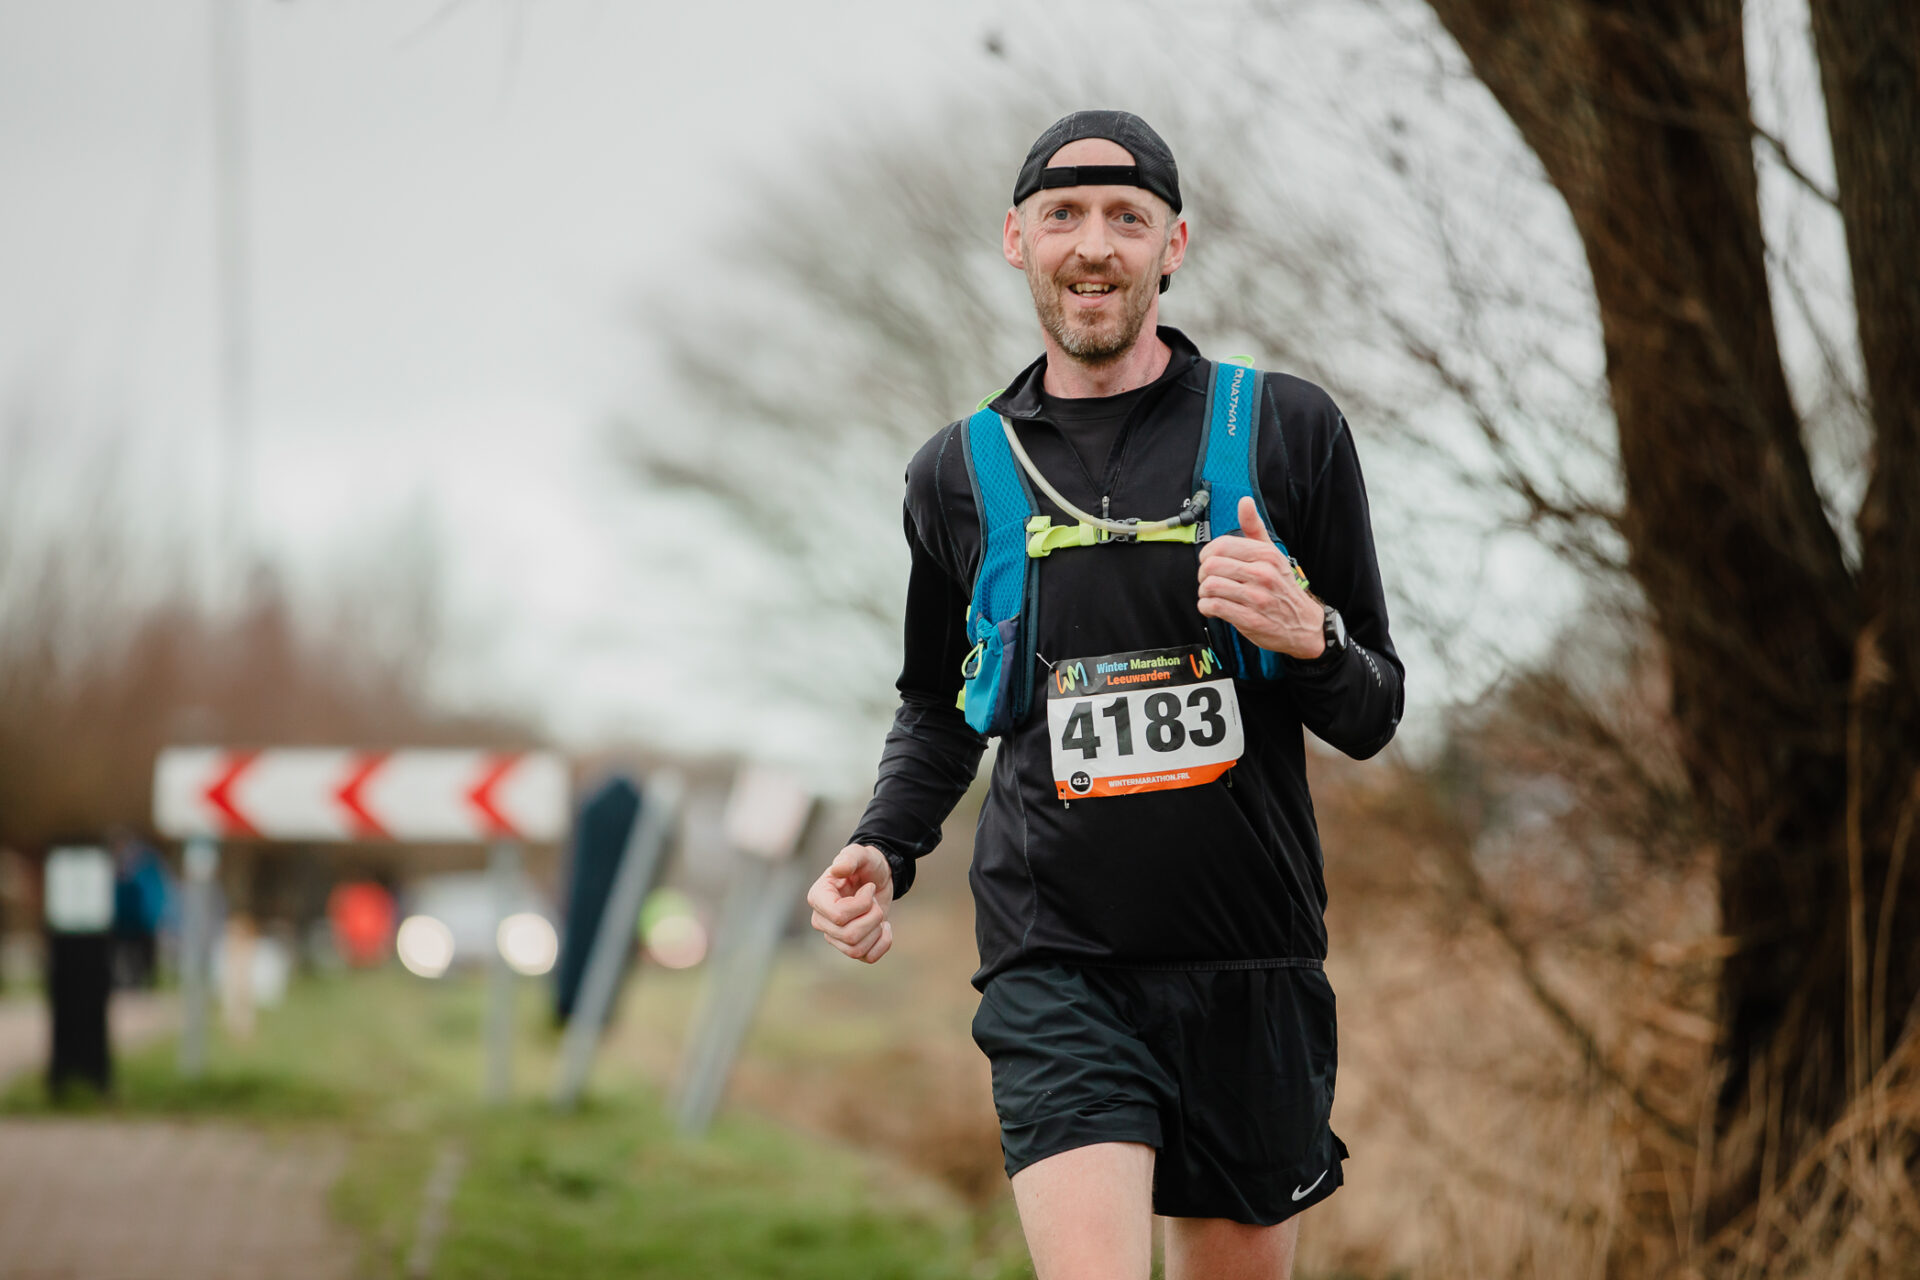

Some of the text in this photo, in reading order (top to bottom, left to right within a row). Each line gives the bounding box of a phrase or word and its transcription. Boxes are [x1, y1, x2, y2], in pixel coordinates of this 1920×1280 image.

[1097, 656, 1181, 674] Winter Marathon
[1107, 669, 1171, 686] Leeuwarden
[1062, 687, 1227, 760] 4183
[1072, 777, 1089, 786] 42.2
[1108, 772, 1191, 787] WINTERMARATHON.FRL
